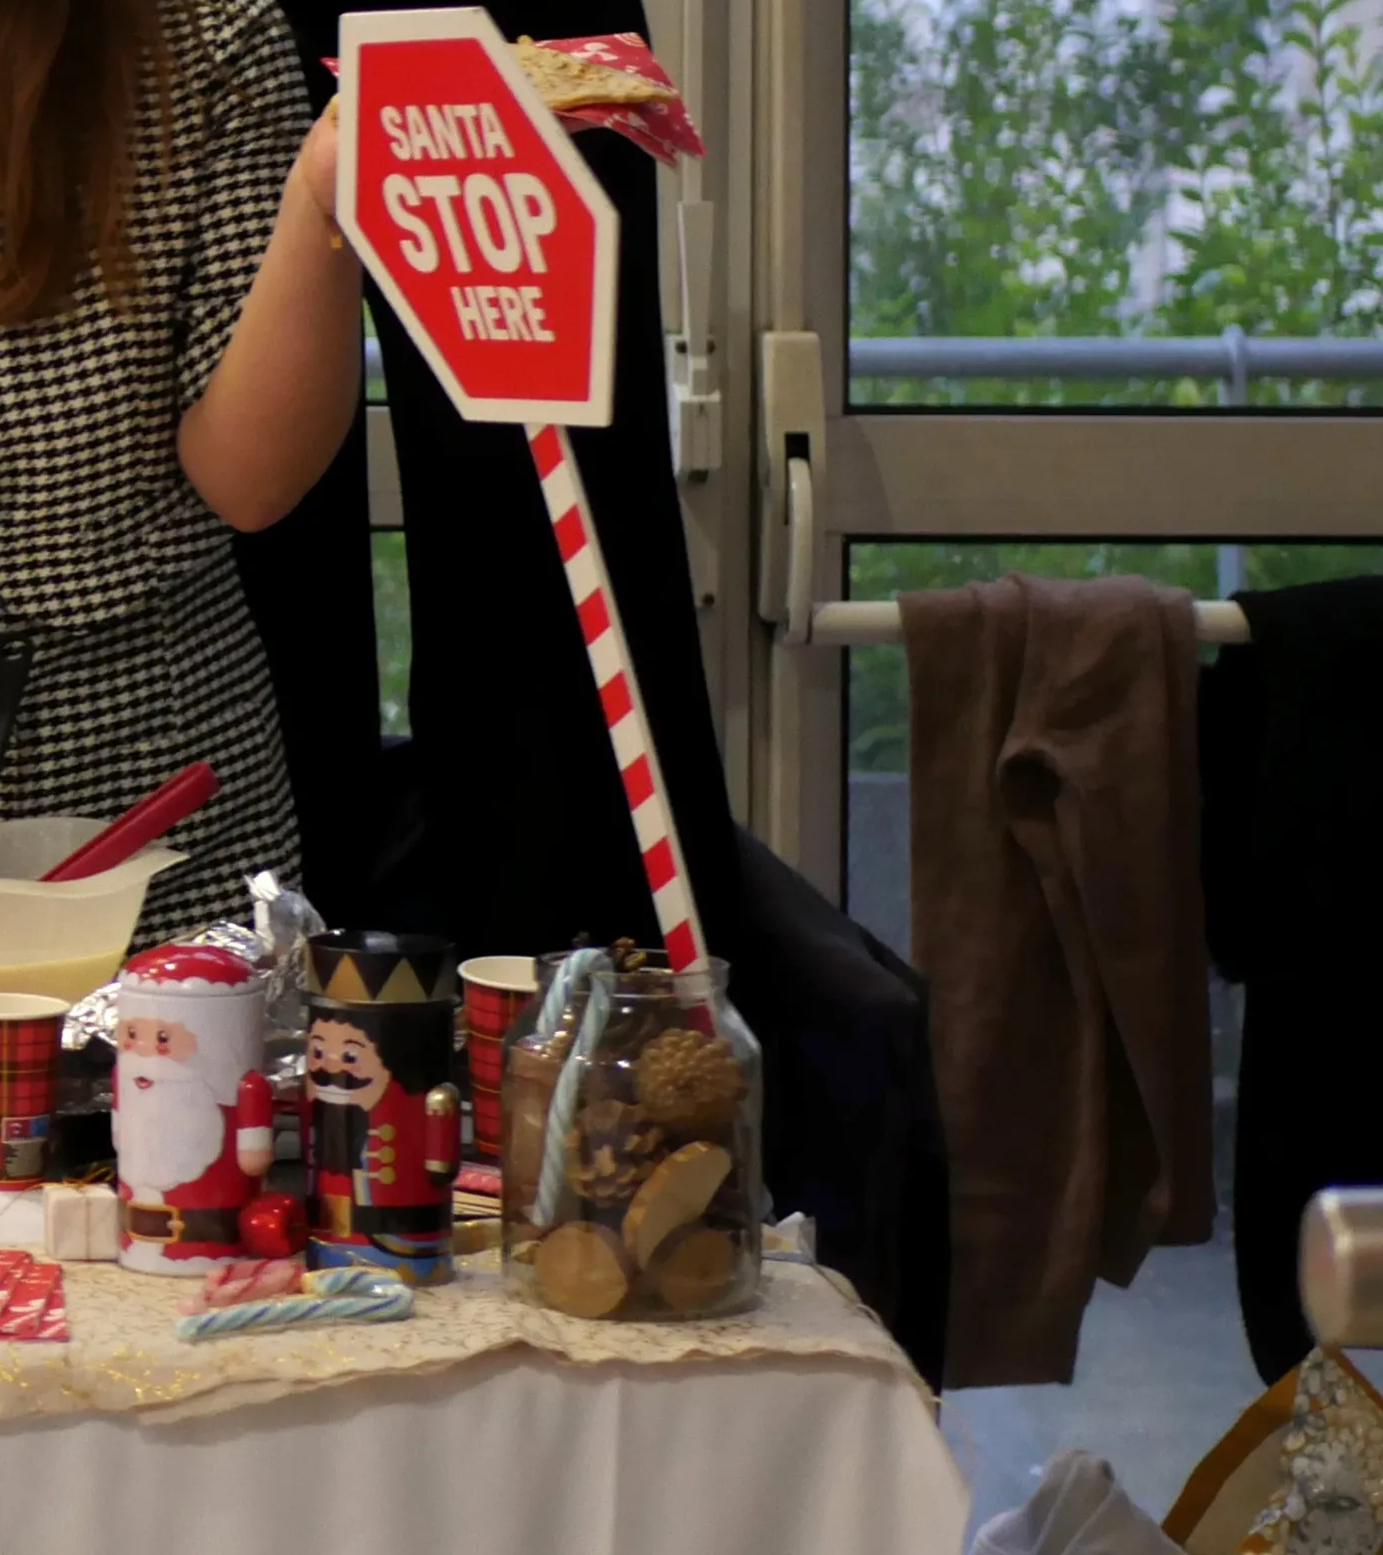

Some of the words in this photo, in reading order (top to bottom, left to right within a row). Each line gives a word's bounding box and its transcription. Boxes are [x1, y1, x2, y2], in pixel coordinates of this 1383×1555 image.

[380, 102, 515, 161] SANTA
[382, 172, 557, 274] STOP
[450, 285, 556, 342] HERE
